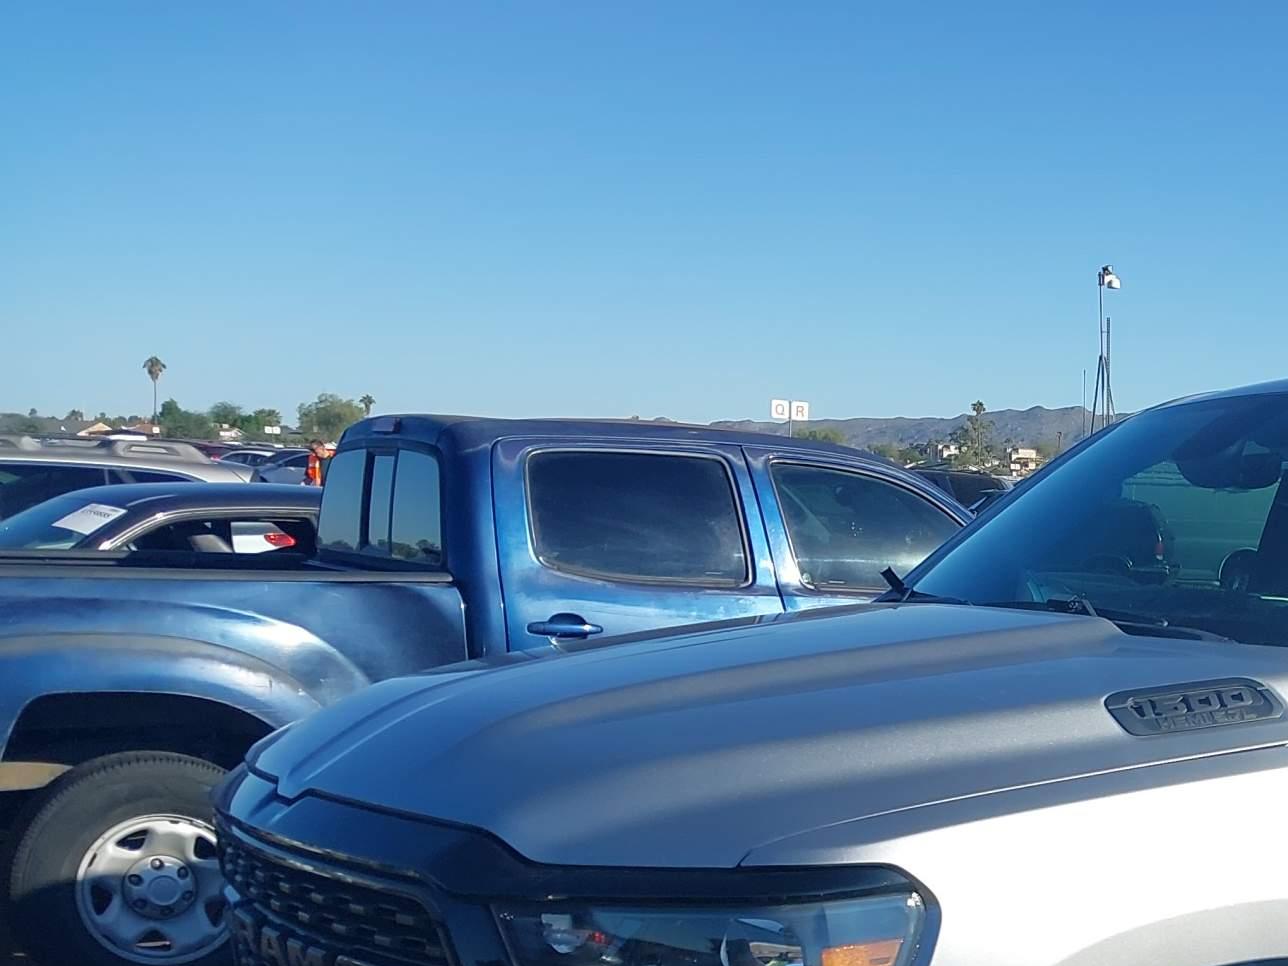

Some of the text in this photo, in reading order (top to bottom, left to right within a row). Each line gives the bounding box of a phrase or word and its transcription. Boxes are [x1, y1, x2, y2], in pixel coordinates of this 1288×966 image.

[774, 403, 785, 416] Q
[796, 405, 805, 416] R
[1127, 686, 1256, 719] 1500
